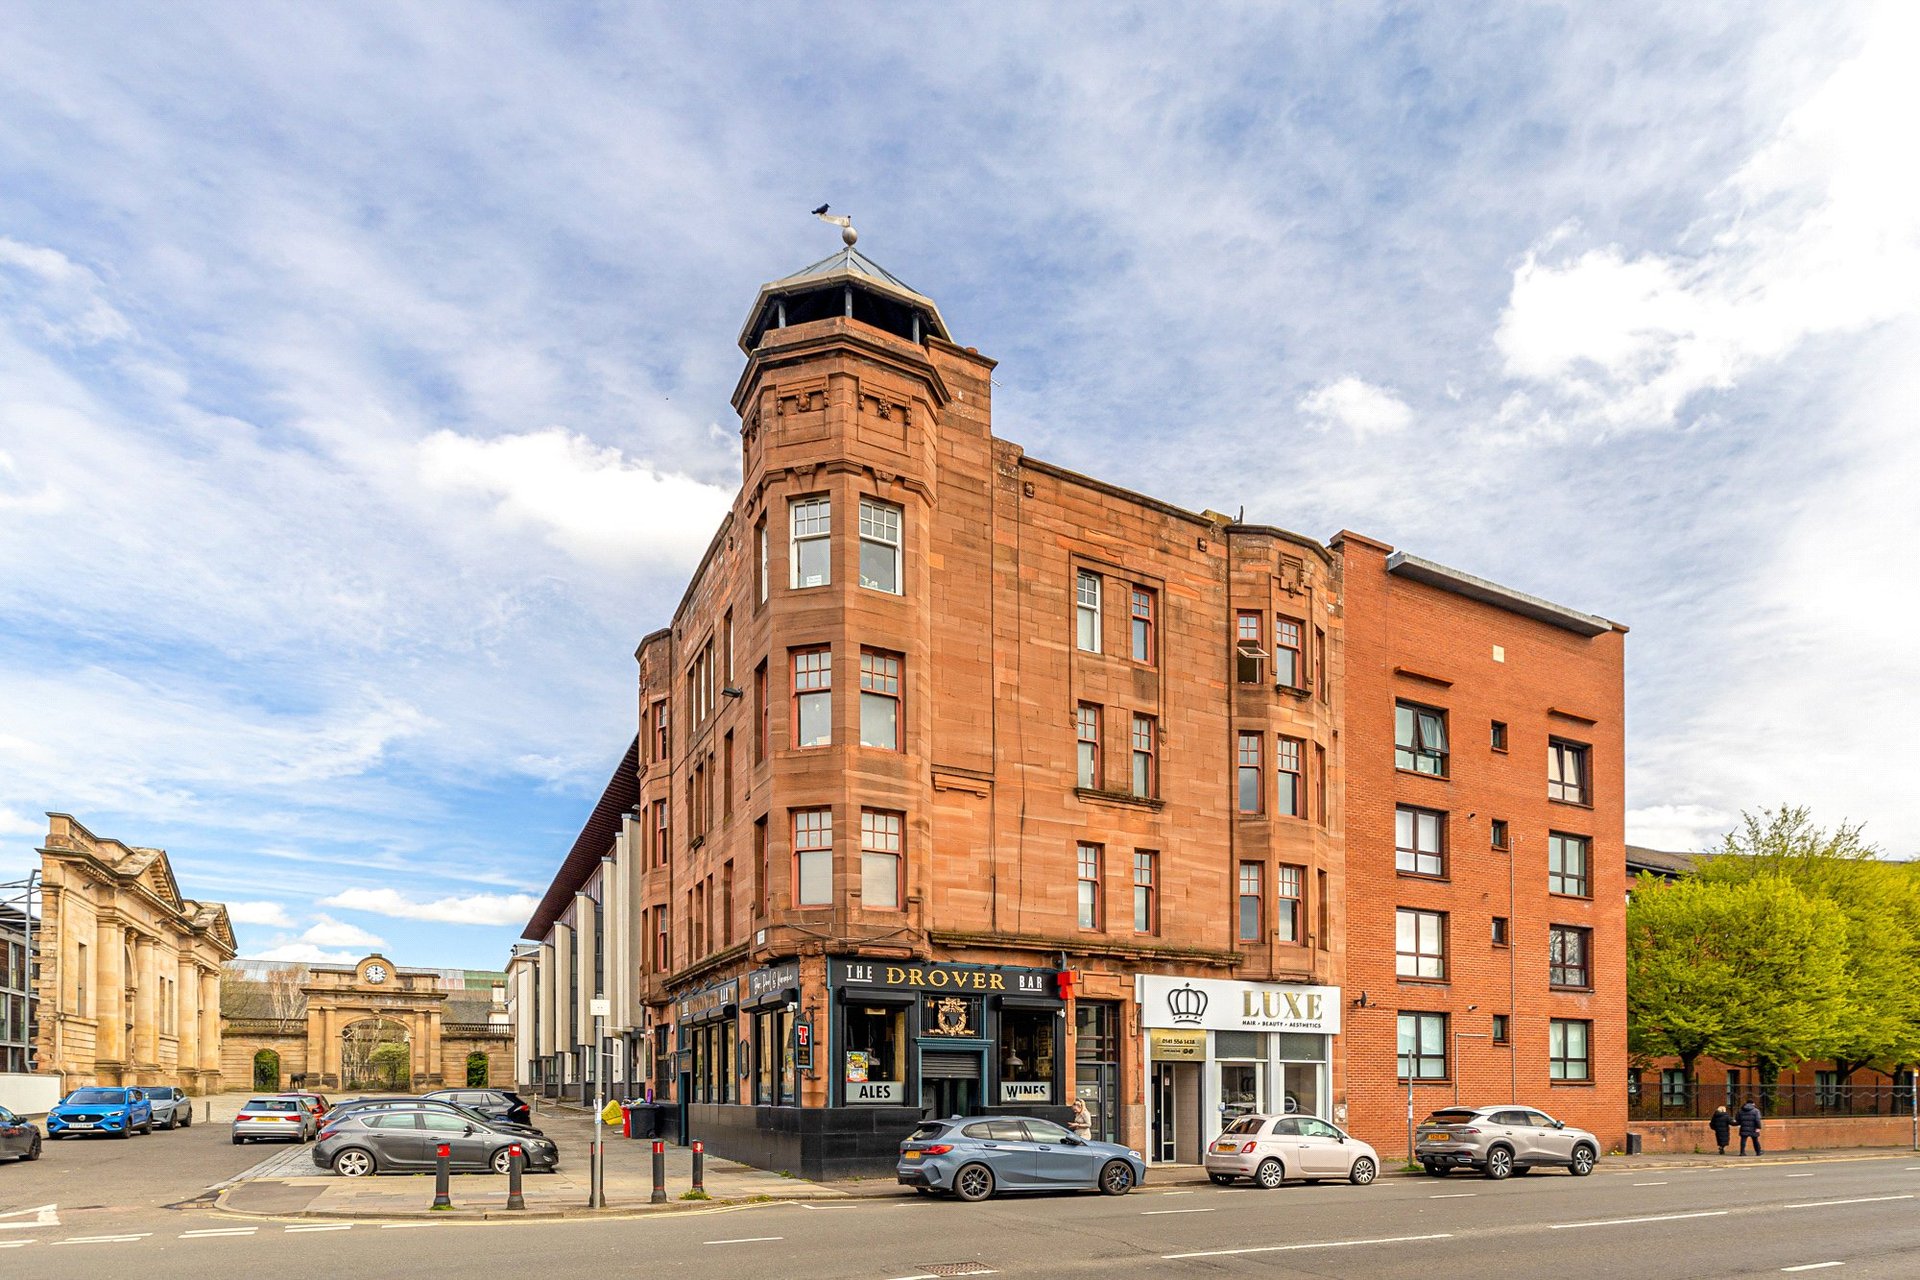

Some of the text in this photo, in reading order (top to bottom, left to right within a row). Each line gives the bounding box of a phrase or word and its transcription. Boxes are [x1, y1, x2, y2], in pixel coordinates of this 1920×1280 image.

[846, 965, 1043, 990] THE DROVER BAR
[1242, 990, 1323, 1020] LUXE
[797, 1024, 809, 1045] T
[859, 1085, 891, 1099] ALES
[1006, 1085, 1046, 1098] WINES
